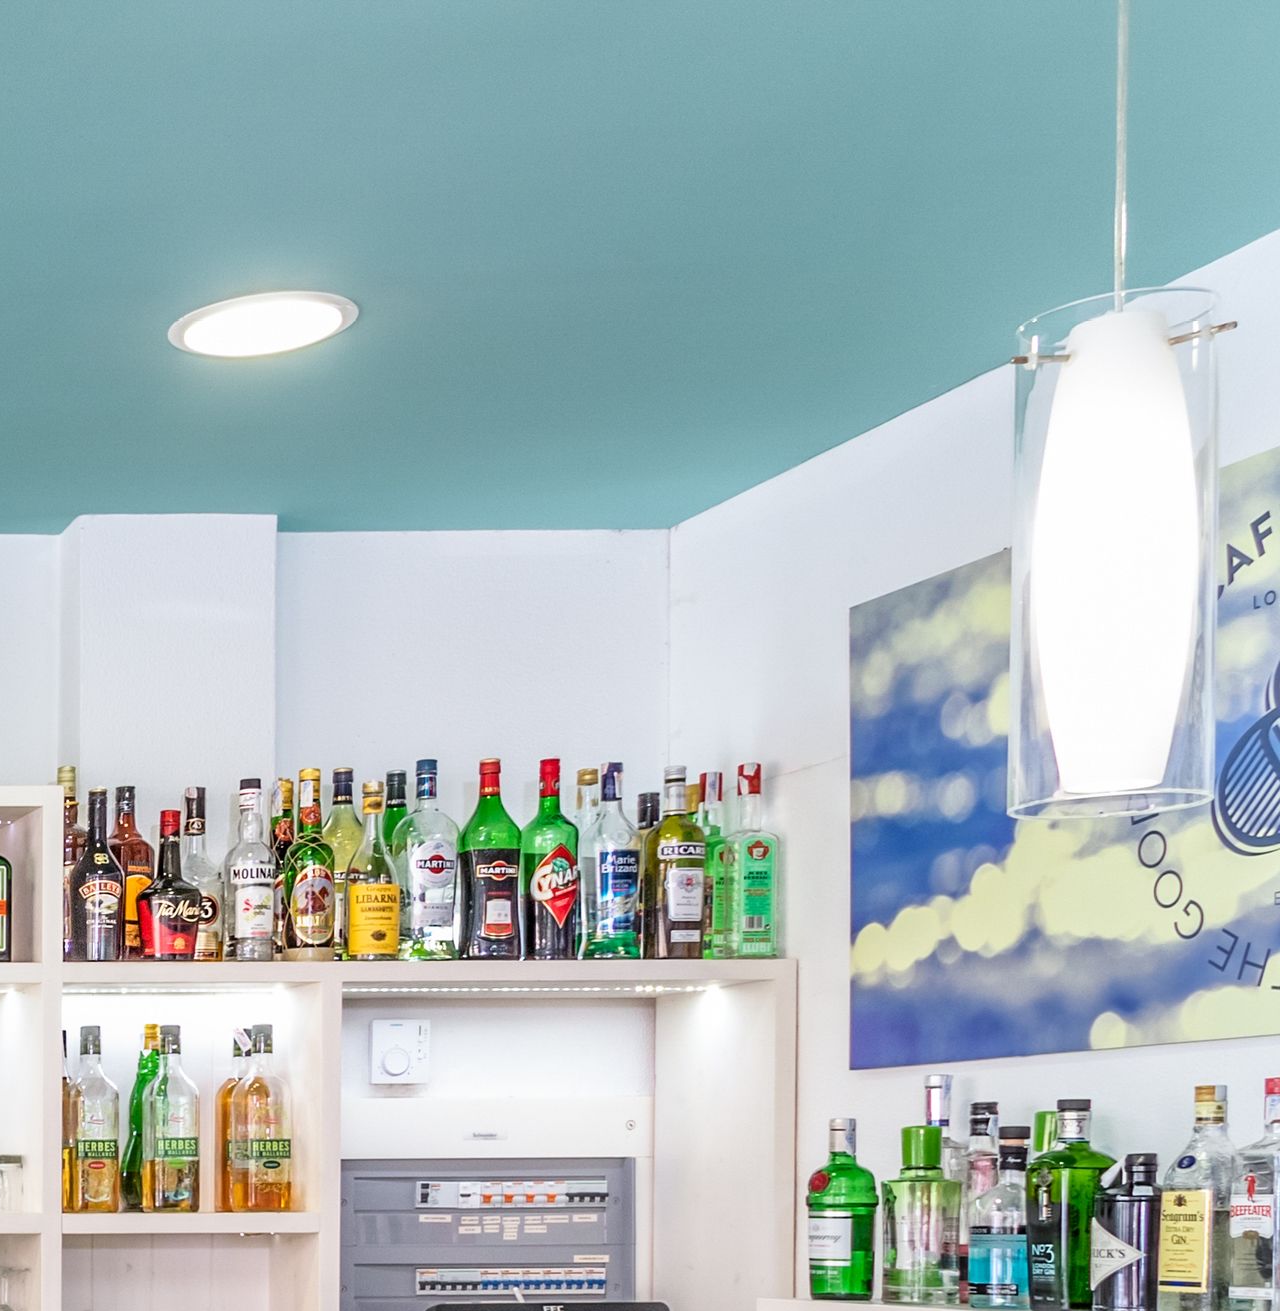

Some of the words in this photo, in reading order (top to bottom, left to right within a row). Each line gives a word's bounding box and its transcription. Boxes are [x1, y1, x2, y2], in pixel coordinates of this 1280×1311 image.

[416, 860, 455, 870] MARTINI
[78, 1141, 116, 1151] HERBES
[157, 1139, 196, 1150] HERBES
[252, 1141, 290, 1151] HERBES
[1229, 1205, 1272, 1217] BEEFEATER
